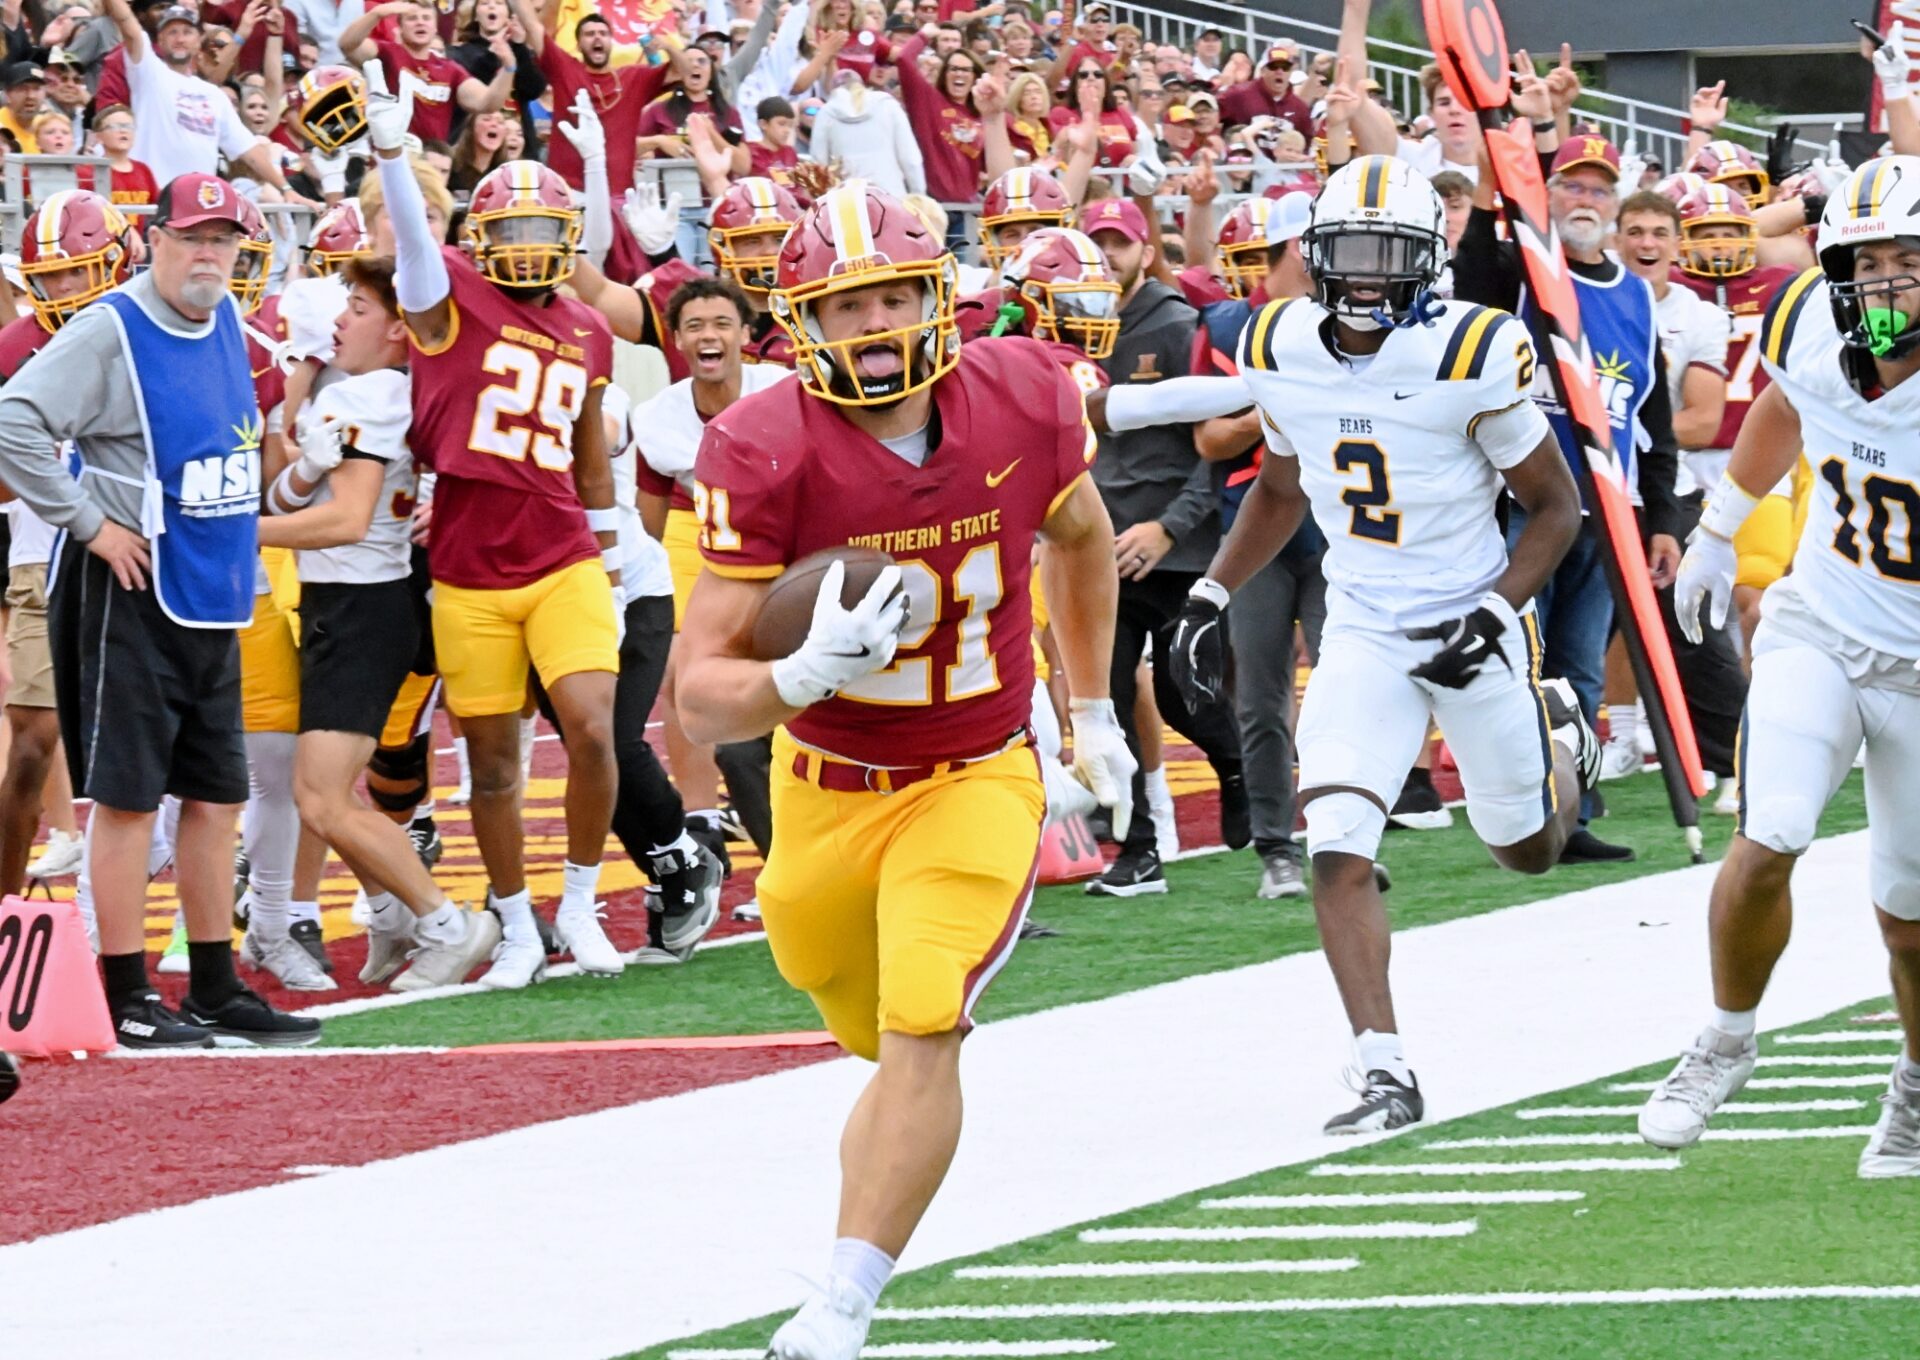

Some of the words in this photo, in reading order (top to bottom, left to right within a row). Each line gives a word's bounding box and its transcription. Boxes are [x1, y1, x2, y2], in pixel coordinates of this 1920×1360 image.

[1841, 221, 1885, 236] Riddell
[863, 384, 889, 394] Riddell
[1514, 338, 1534, 391] 2
[467, 340, 587, 472] 29
[1339, 418, 1373, 434] BEARS
[181, 450, 260, 502] NSI
[1851, 441, 1887, 468] BEARS
[1331, 438, 1403, 549] 2
[951, 508, 1001, 543] STATE
[1818, 455, 1920, 585] 10
[835, 541, 1004, 707] 21
